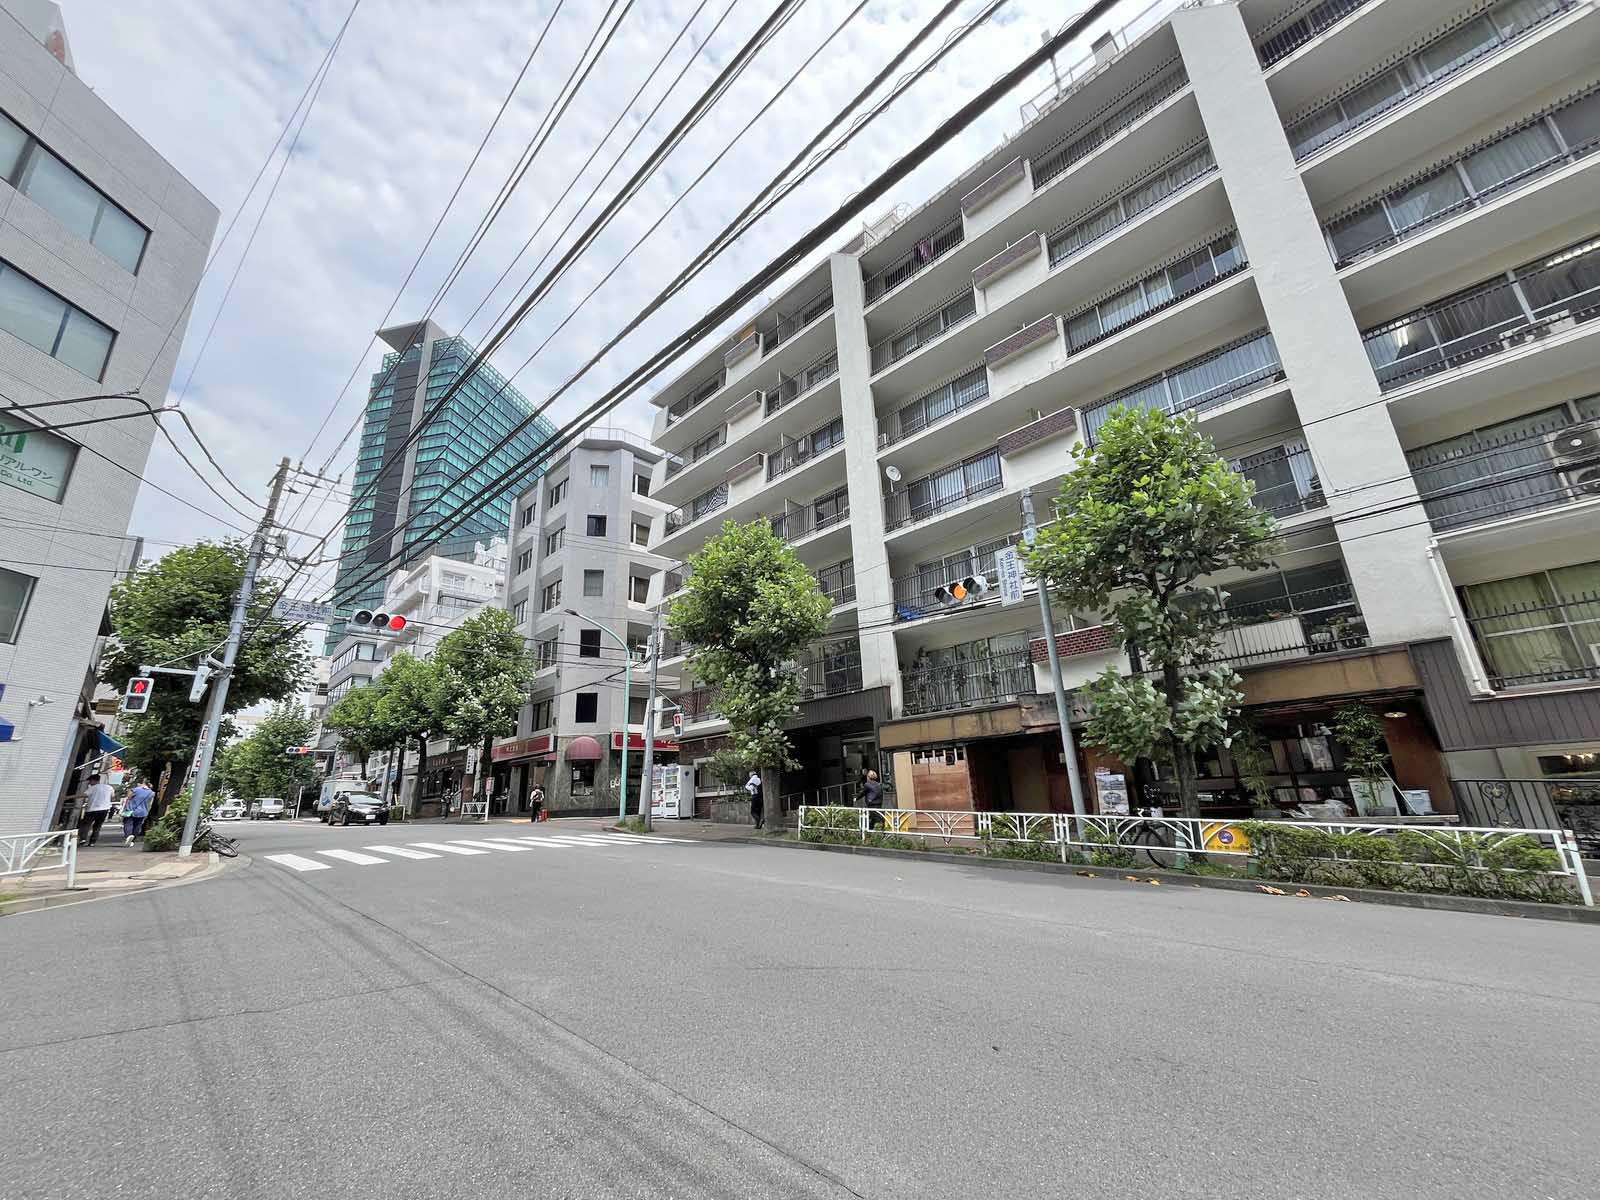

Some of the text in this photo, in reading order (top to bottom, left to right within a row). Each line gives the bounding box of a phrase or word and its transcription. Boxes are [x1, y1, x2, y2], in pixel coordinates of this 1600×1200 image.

[1005, 551, 1020, 600] 金王神社前
